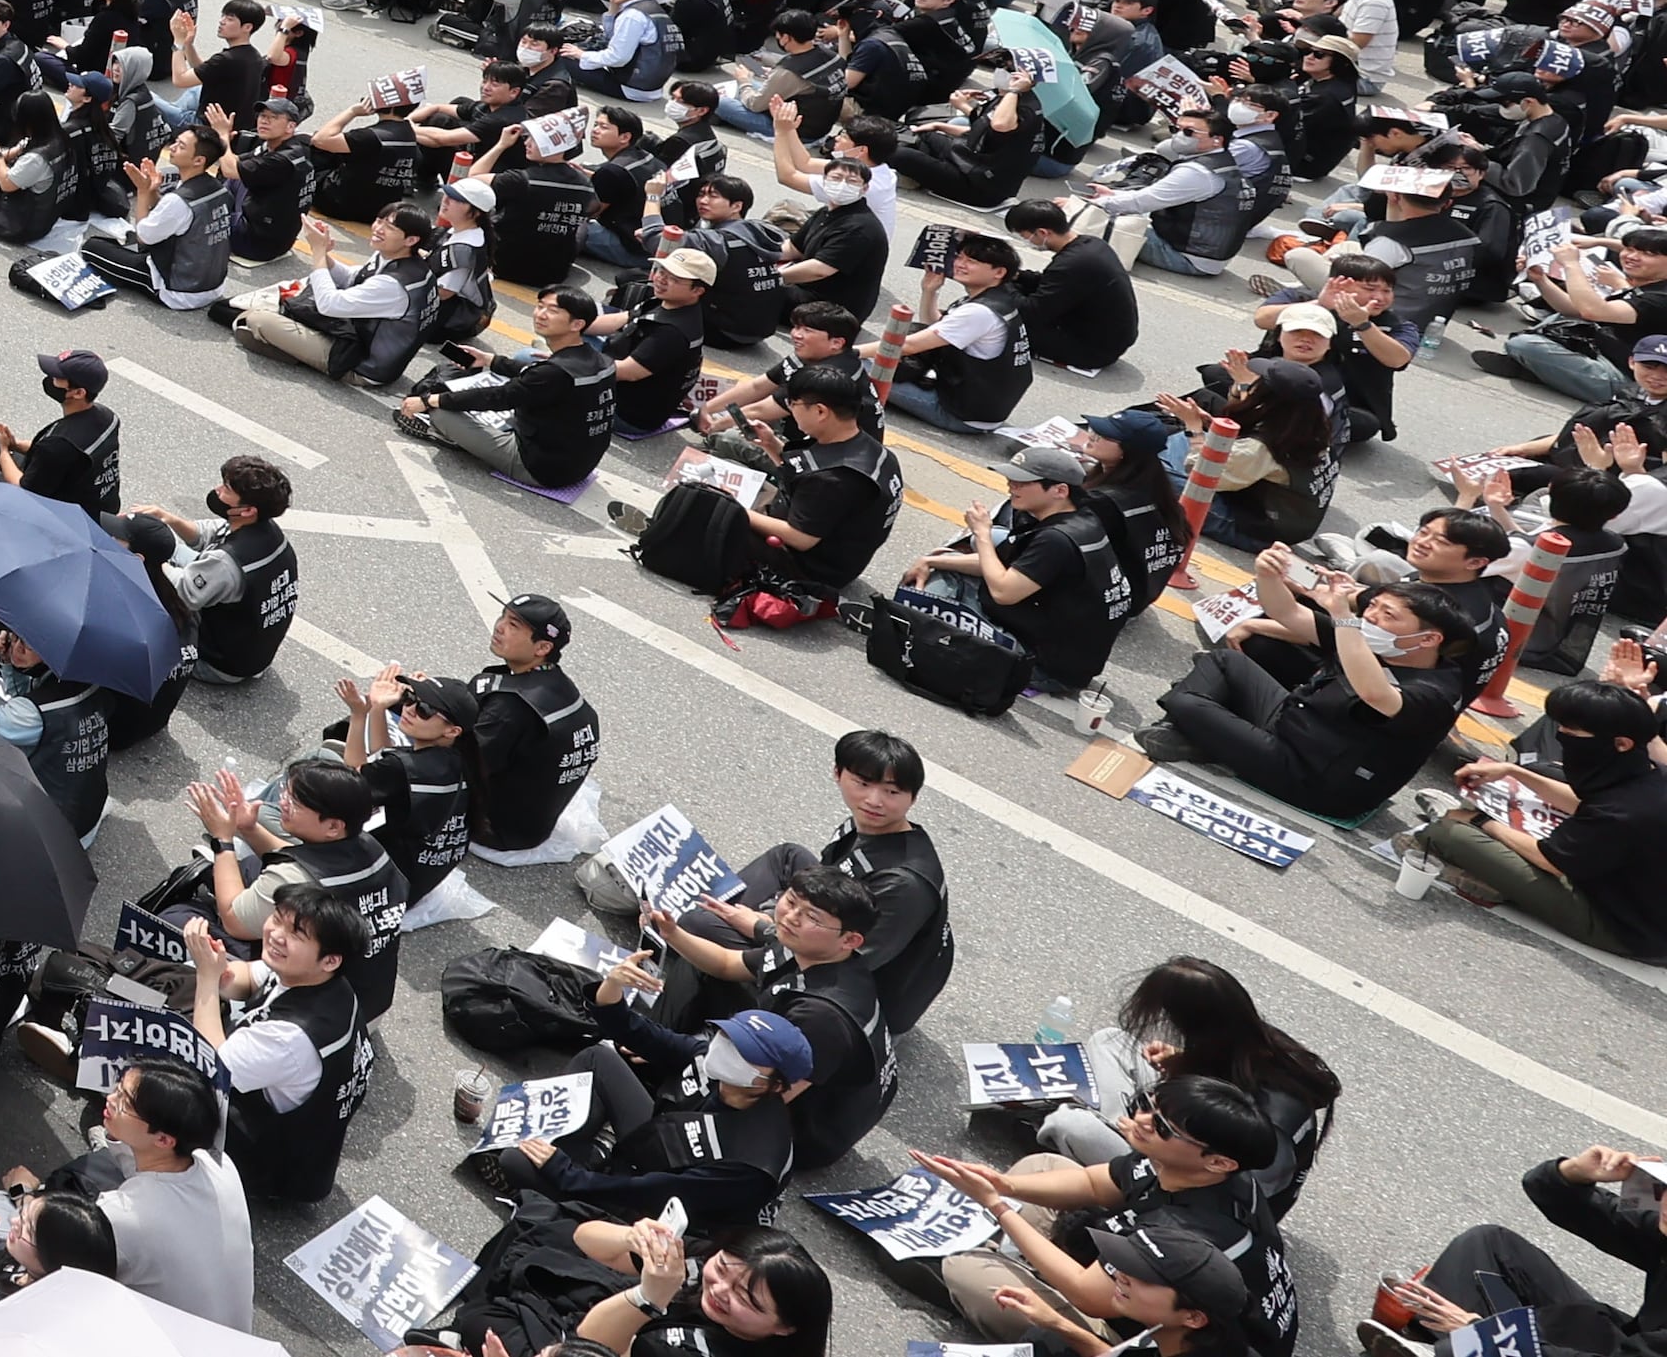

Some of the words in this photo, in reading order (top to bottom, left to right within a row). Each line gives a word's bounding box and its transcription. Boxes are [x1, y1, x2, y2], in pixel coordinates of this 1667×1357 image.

[1149, 798, 1296, 861] 실현하자
[1155, 780, 1290, 841] 상한폐지
[85, 1013, 218, 1079] 실현하자
[684, 1121, 704, 1159] SELU
[828, 1172, 934, 1222] 실현하자
[316, 1208, 394, 1301] 상한폐지
[372, 1240, 452, 1338] 실현하자
